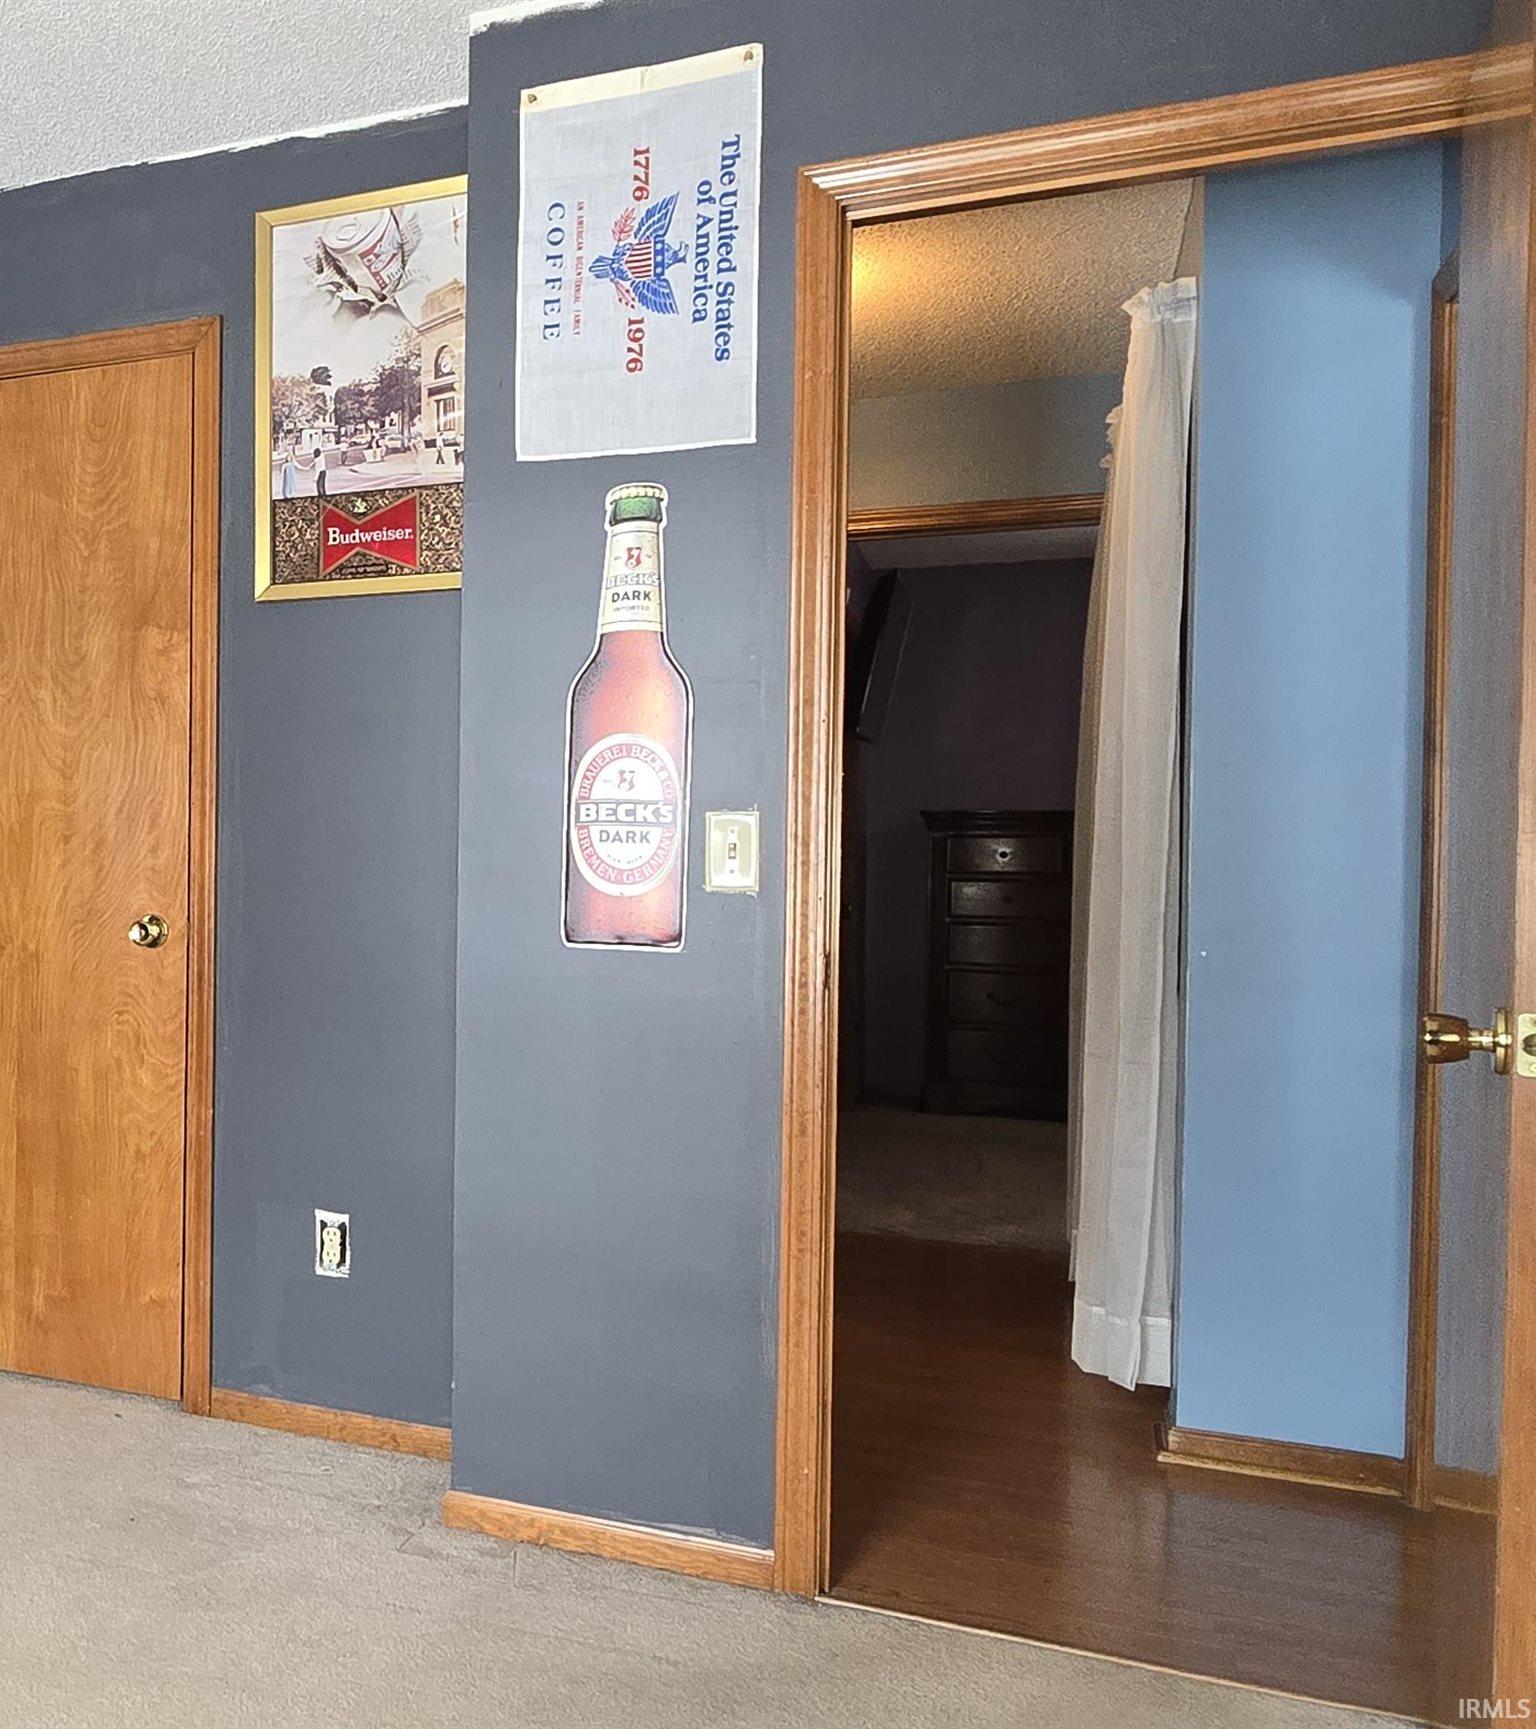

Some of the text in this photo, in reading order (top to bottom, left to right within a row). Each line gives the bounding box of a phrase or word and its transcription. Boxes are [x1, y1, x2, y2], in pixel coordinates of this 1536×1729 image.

[542, 201, 566, 342] COFFEE
[625, 146, 651, 374] 1776 1976
[692, 179, 716, 324] of America
[714, 133, 741, 363] The United States
[611, 590, 652, 603] DARK
[579, 745, 629, 800] BRAUEREI
[579, 802, 674, 824] BECK'S
[598, 829, 651, 844] DARK
[577, 828, 617, 883] BREMEN
